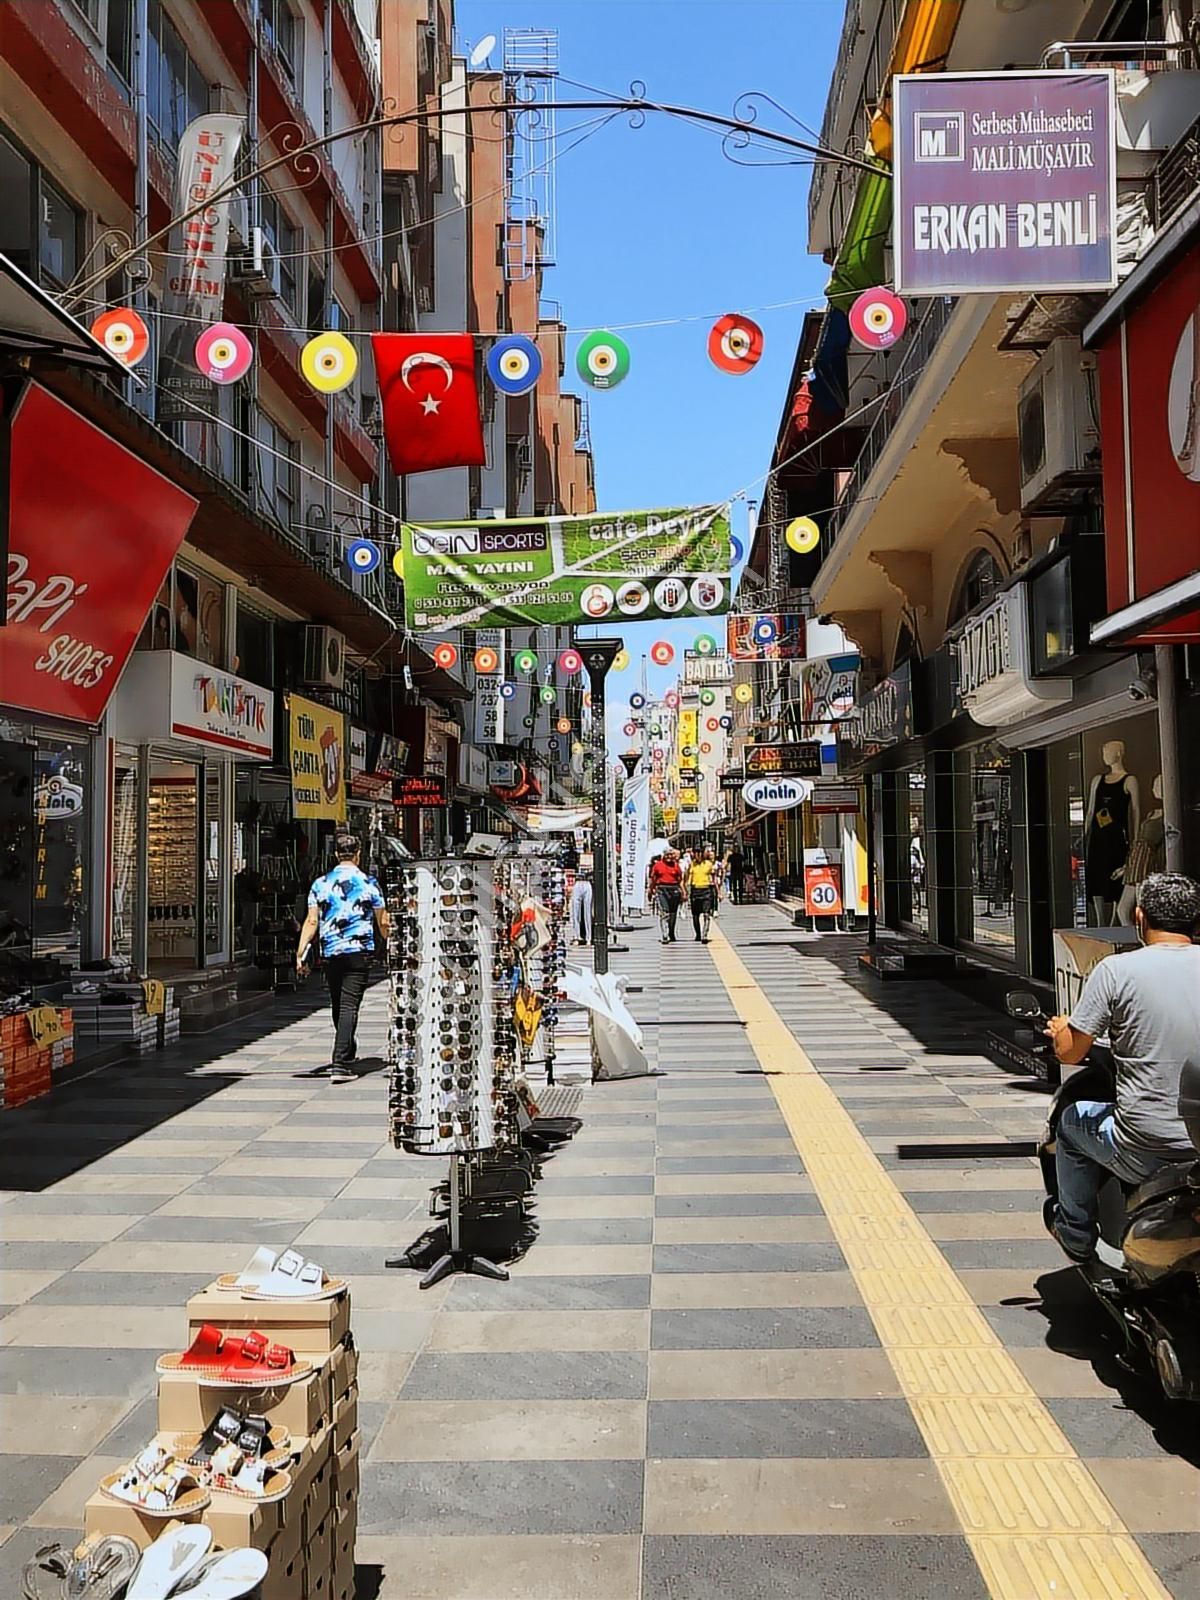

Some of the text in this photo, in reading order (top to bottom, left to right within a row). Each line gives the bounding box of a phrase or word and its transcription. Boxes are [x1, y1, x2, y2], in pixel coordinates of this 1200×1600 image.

[972, 108, 1094, 136] Serbest Muhasebeci
[972, 137, 1094, 176] MALİ MÜŞAVİR
[913, 193, 1098, 255] ERKAN BENLİ
[588, 516, 639, 541] cafe
[484, 532, 545, 550] SPORTS
[473, 560, 534, 574] YAYINI
[35, 635, 114, 688] SHOES
[481, 695, 500, 706] 237
[485, 710, 498, 722] 58
[483, 726, 497, 738] 58
[754, 784, 797, 803] platin
[626, 819, 638, 867] Telekom
[813, 886, 835, 904] 30
